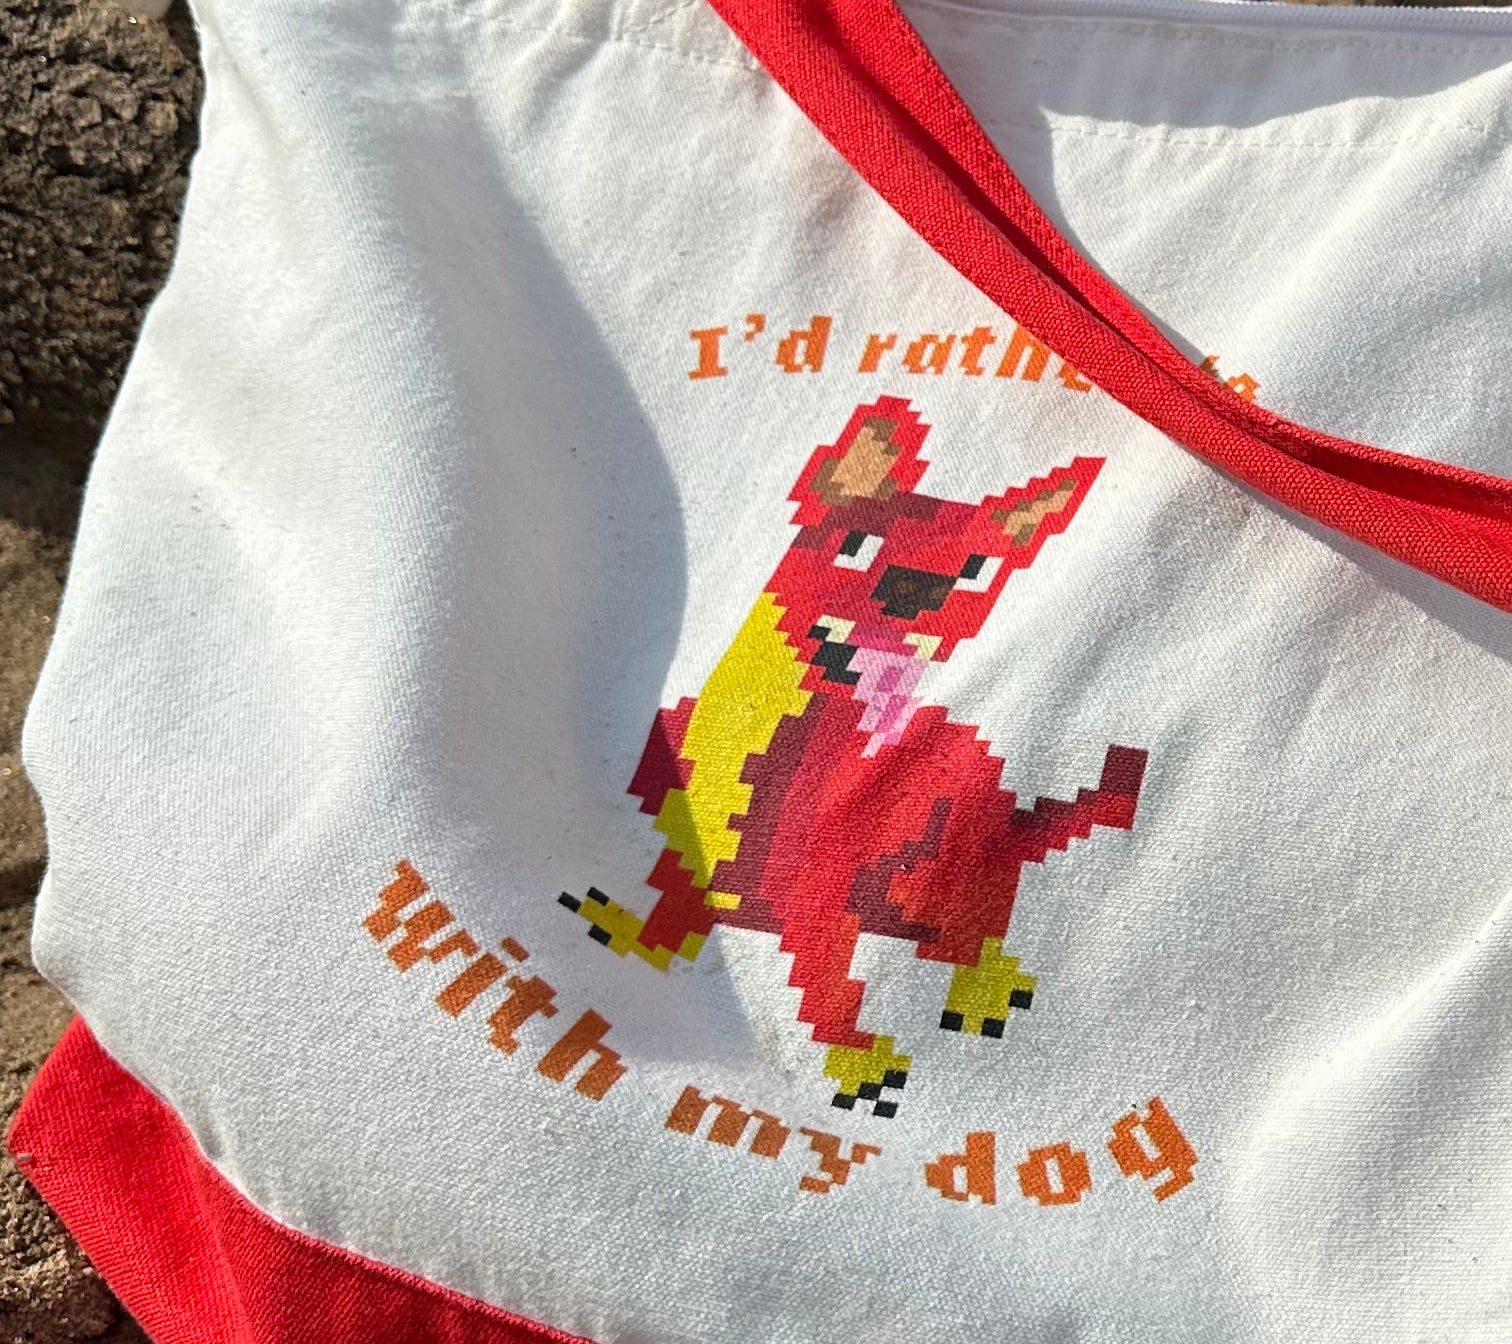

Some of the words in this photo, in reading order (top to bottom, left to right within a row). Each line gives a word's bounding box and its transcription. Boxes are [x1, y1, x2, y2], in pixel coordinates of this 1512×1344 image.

[689, 313, 832, 380] I'd
[858, 324, 1094, 393] rath
[664, 1086, 882, 1194] my
[926, 1097, 1198, 1205] dog
